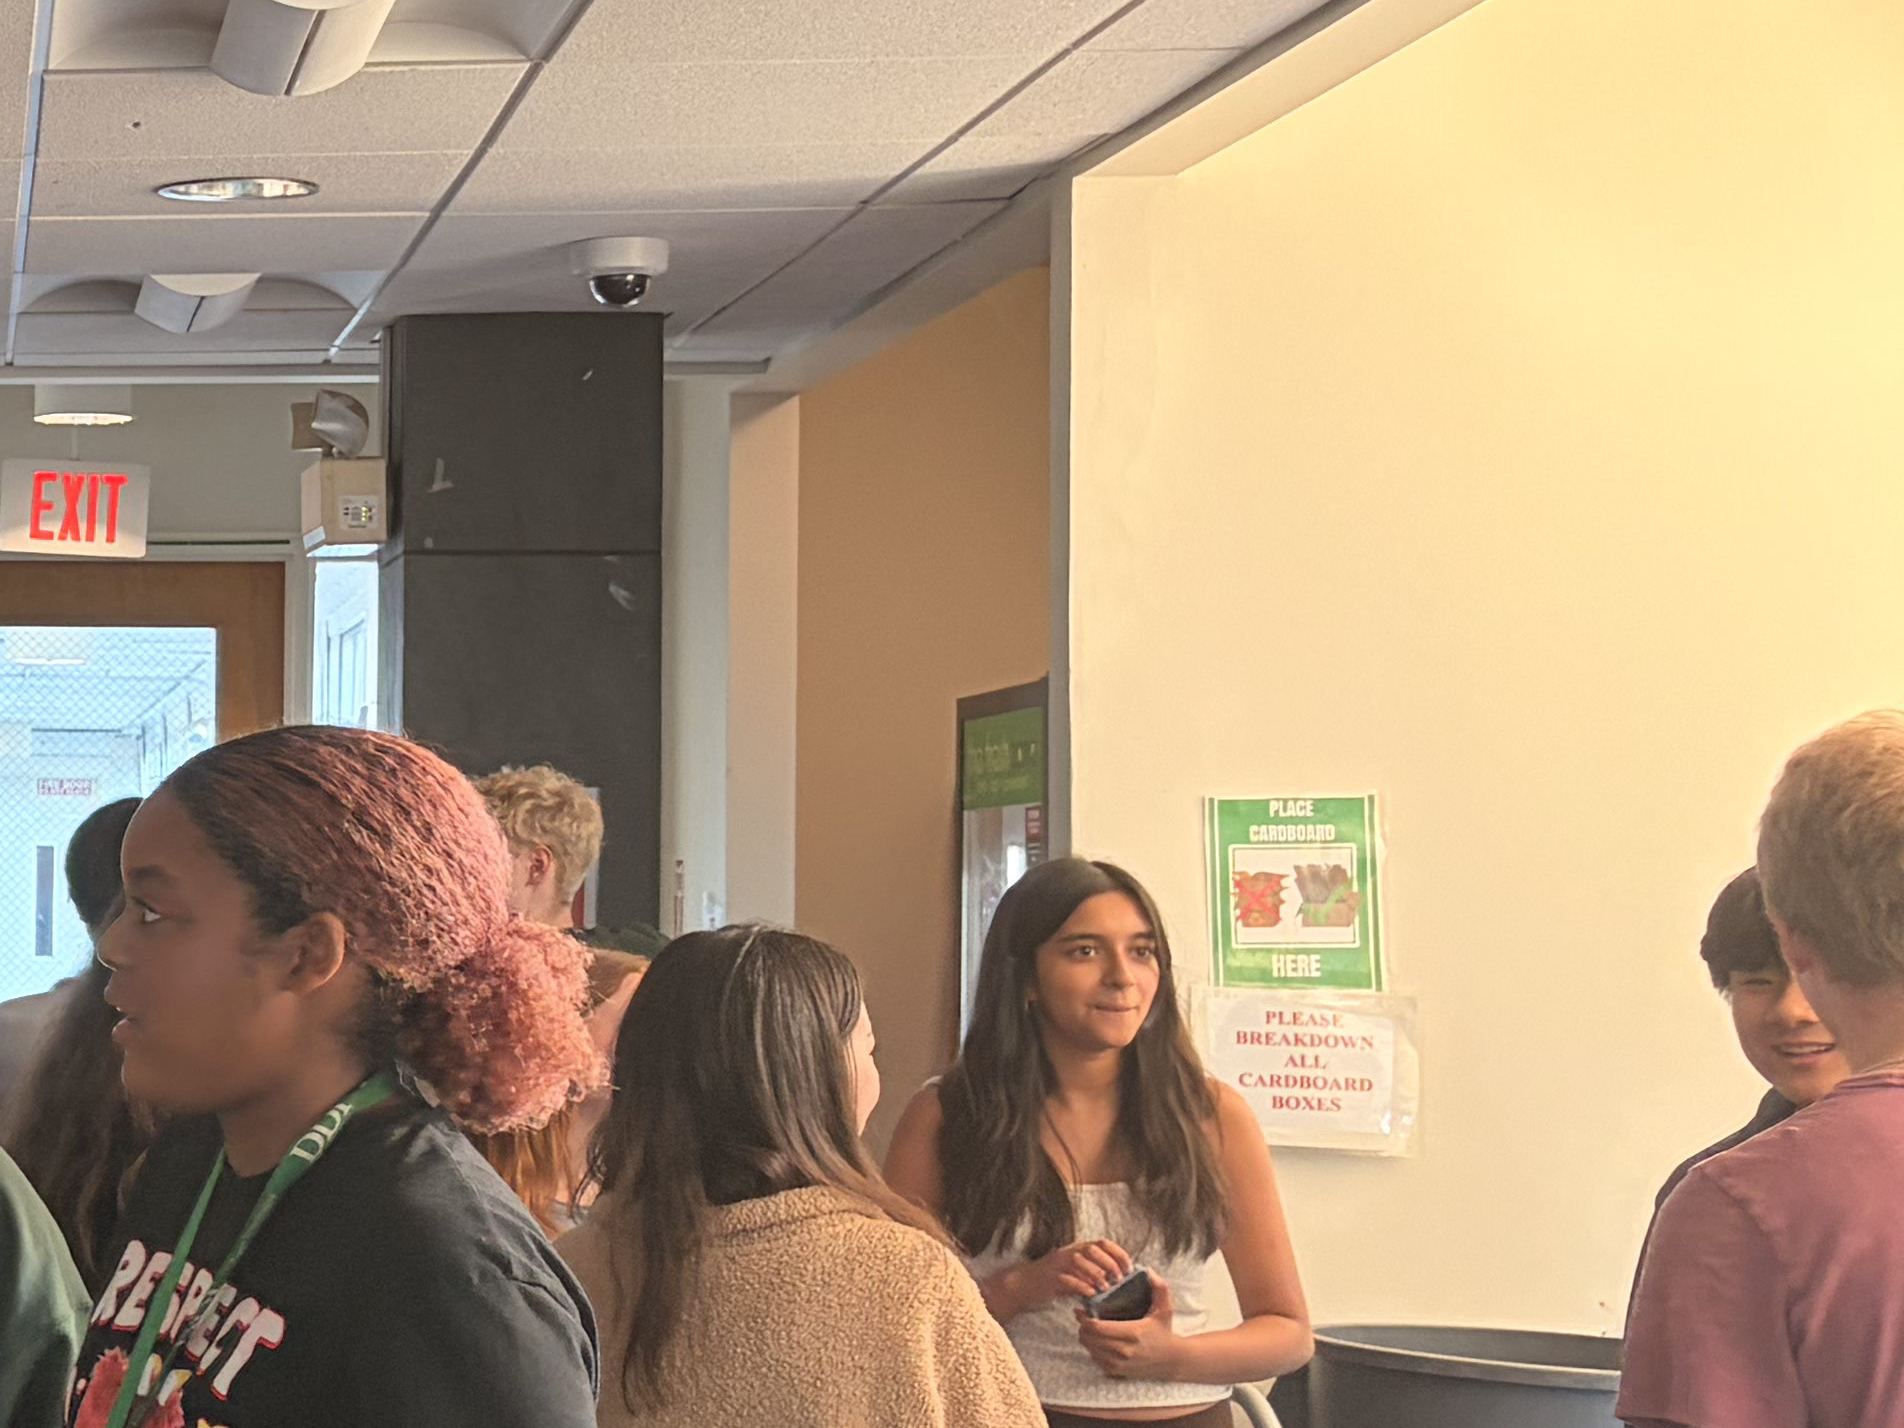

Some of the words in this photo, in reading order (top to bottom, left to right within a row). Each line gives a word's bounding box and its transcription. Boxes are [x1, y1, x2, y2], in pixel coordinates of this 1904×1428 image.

[28, 469, 129, 545] EXIT
[1268, 799, 1315, 818] PLACE
[1248, 823, 1336, 843] CARDBOARD
[1271, 953, 1322, 979] HERE
[1264, 1009, 1344, 1029] PLEASE
[1235, 1030, 1375, 1051] BREAKDOWN
[1283, 1053, 1328, 1071] ALL
[1237, 1072, 1374, 1094] CARDBOARD
[1271, 1095, 1342, 1113] BOXES
